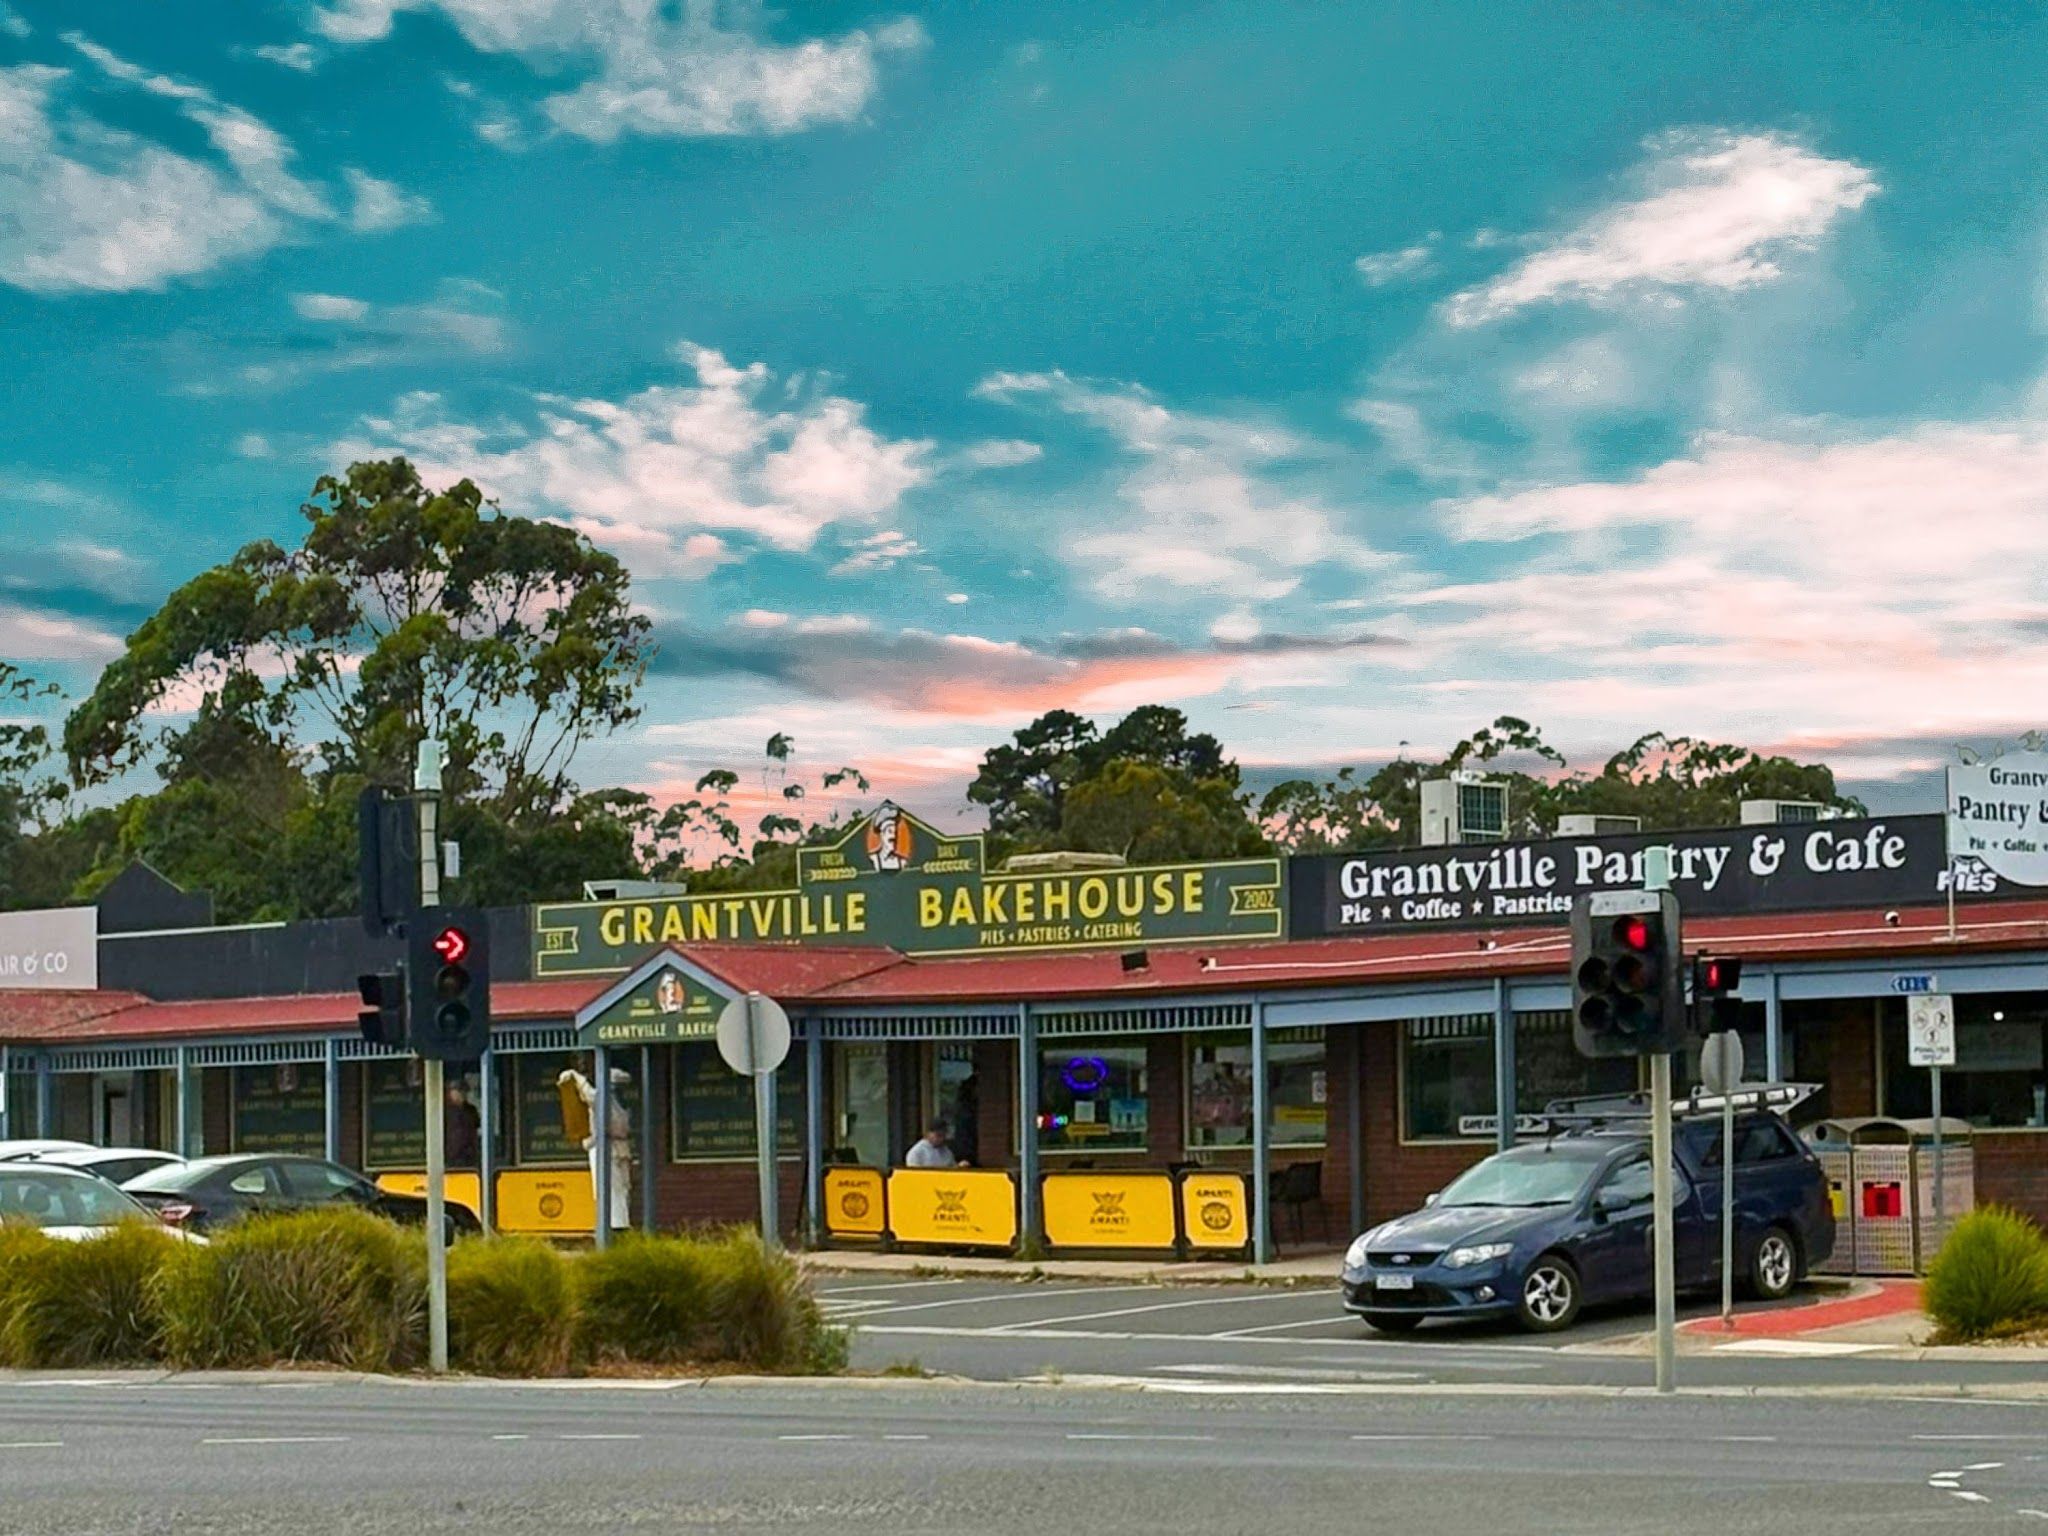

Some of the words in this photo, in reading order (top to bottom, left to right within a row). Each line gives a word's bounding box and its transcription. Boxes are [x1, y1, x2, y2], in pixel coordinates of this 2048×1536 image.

[1958, 796, 2030, 829] Pantry
[1340, 846, 1557, 899] Grantville
[1749, 834, 1785, 876] &
[1804, 825, 1907, 873] Cafe
[600, 893, 866, 945] GRANTVILLE
[919, 873, 1204, 928] BAKEHOUSE
[1340, 904, 1372, 925] Pie
[1402, 898, 1462, 921] Coffee
[1493, 892, 1573, 915] Pastries
[1018, 926, 1071, 943] PASTRIES
[1083, 922, 1142, 940] CATERING
[44, 952, 68, 973] CO
